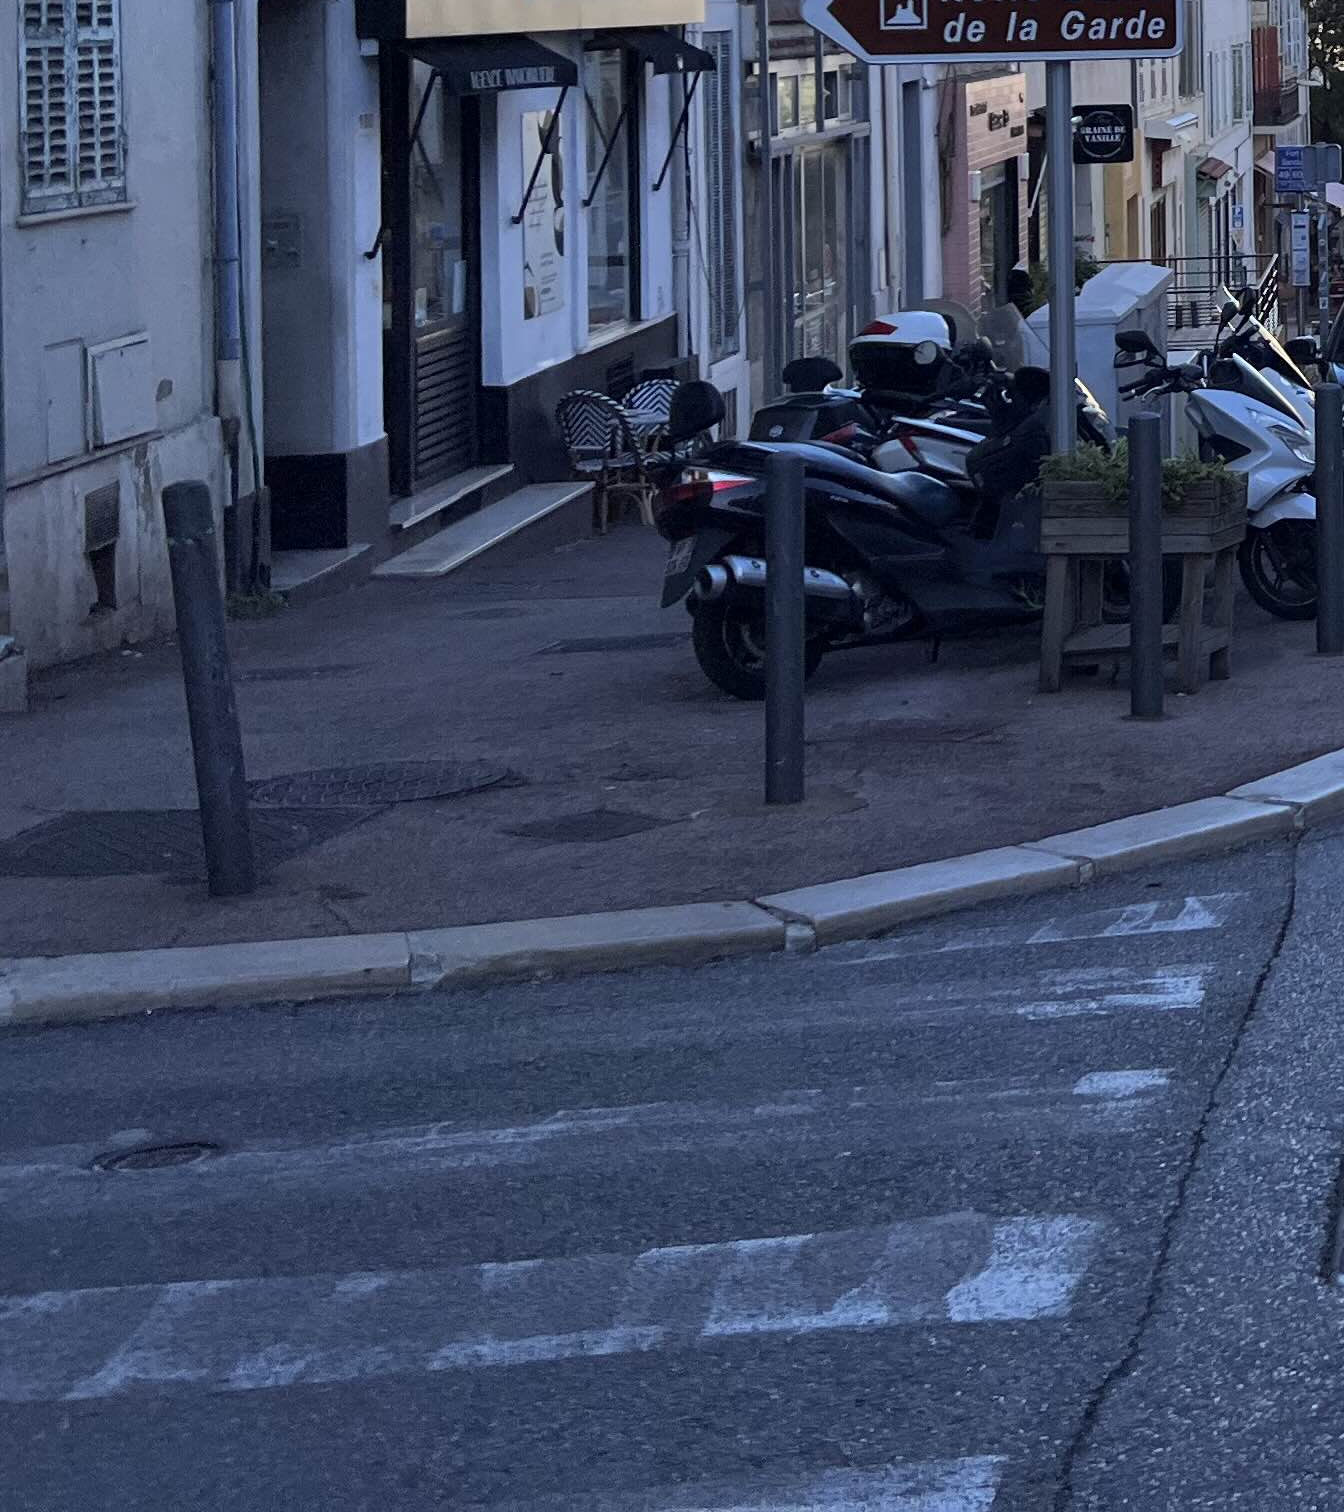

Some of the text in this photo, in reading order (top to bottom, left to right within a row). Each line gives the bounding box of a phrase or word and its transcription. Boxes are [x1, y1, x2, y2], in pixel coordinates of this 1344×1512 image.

[943, 9, 1167, 43] de la Garde
